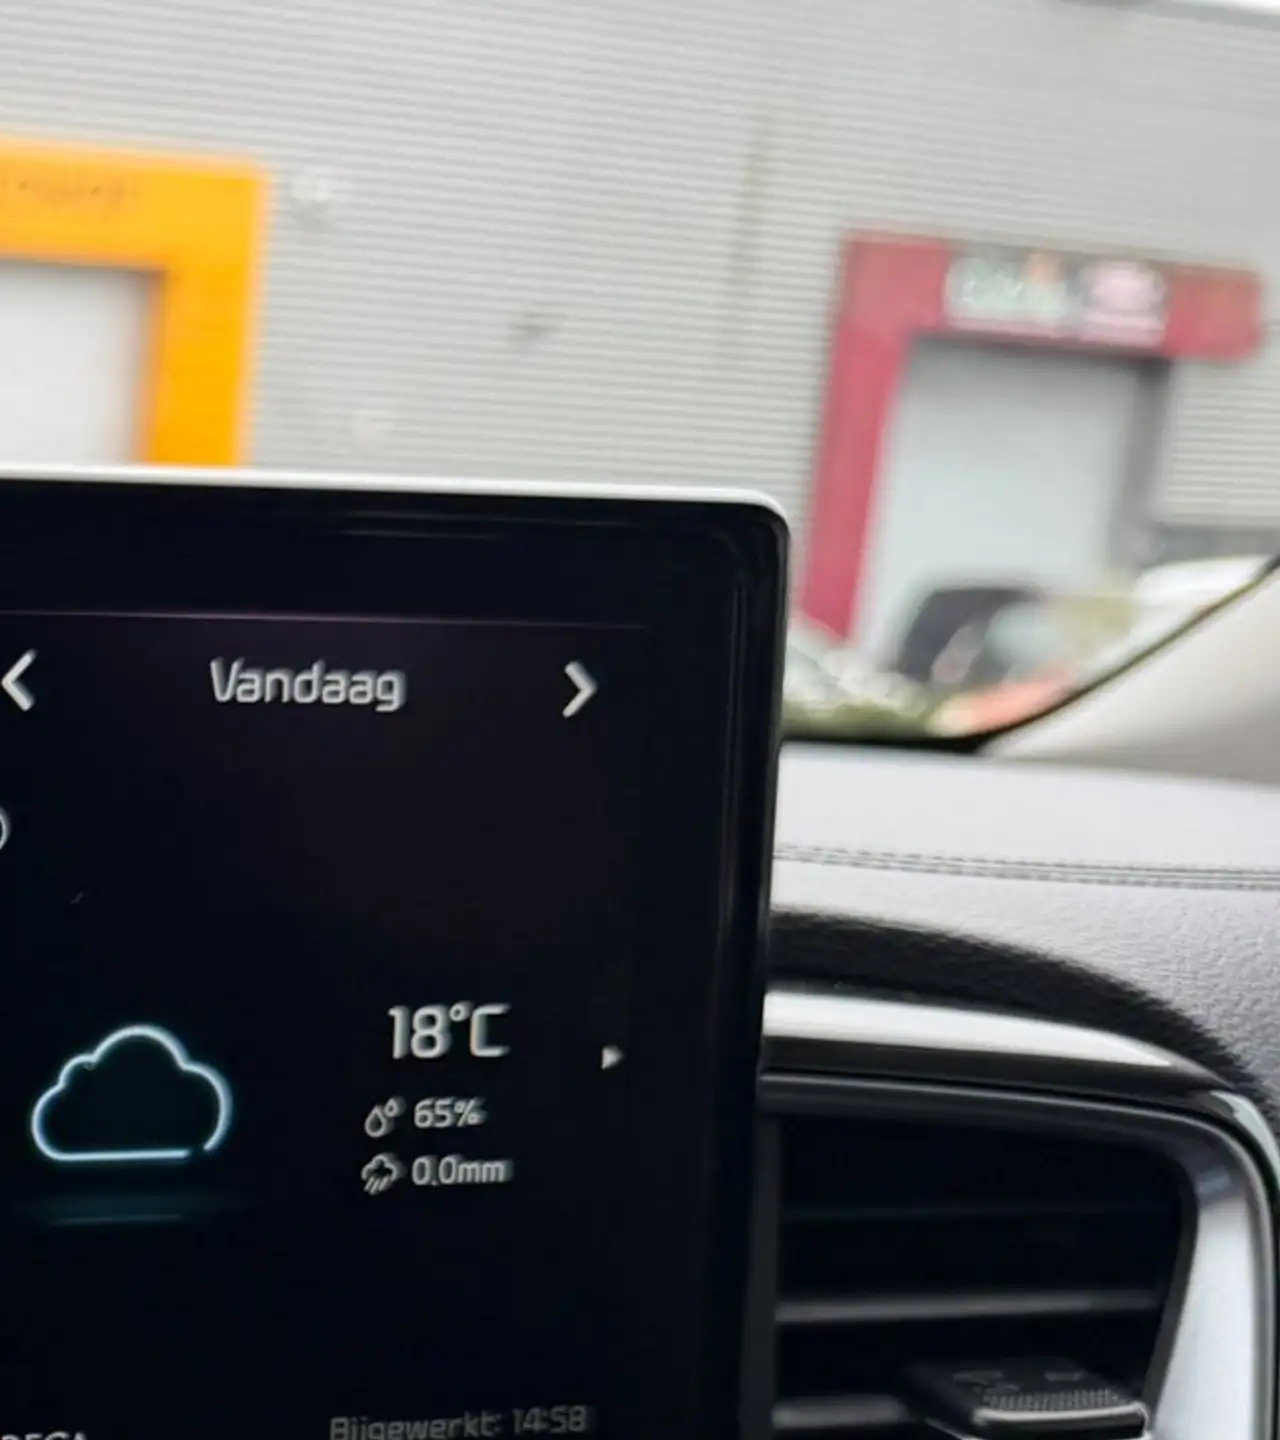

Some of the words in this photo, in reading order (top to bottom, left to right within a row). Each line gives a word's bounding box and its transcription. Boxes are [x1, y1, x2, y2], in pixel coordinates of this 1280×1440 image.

[209, 656, 407, 713] Vandaag
[387, 1001, 511, 1060] 18°C
[414, 1096, 488, 1129] 65%
[411, 1154, 513, 1187] 0.0mm
[512, 1404, 591, 1434] 14:58
